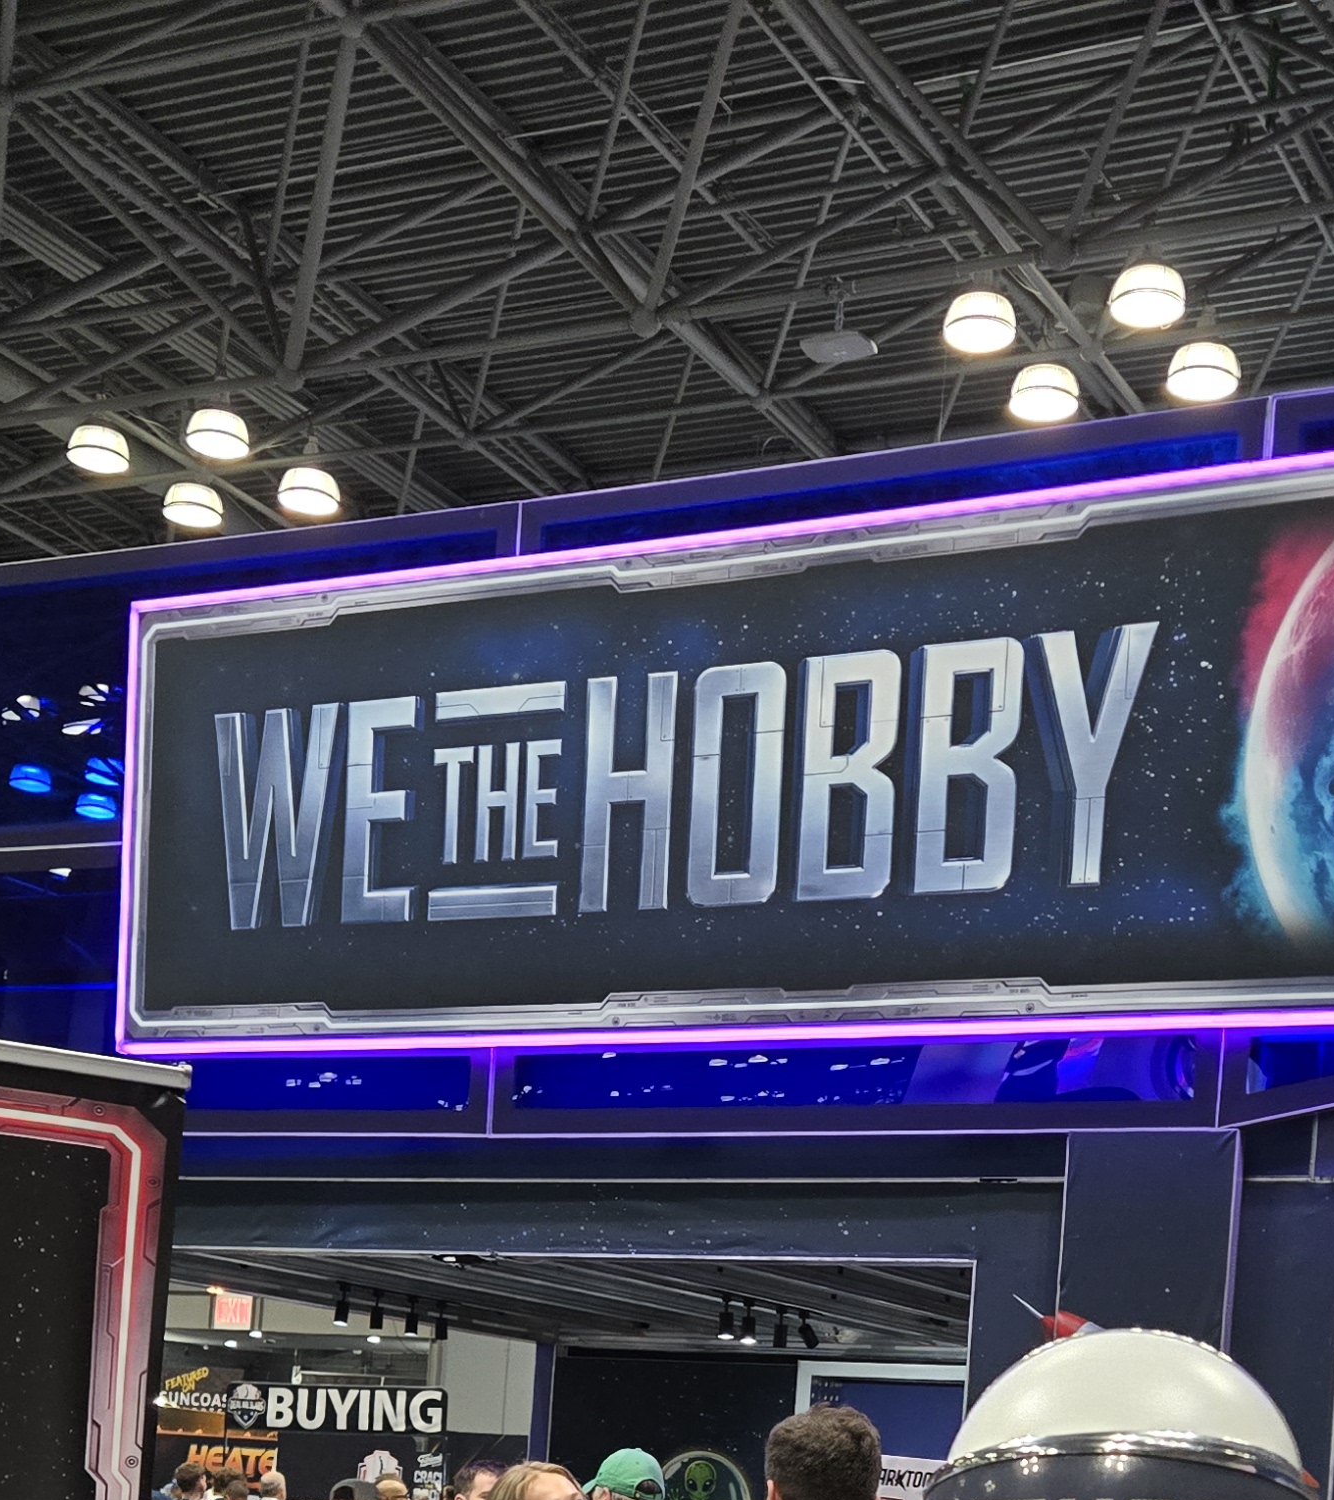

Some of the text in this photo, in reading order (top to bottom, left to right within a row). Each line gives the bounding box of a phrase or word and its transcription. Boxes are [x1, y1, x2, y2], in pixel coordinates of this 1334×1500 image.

[215, 620, 1160, 929] WE THE HOBBY
[219, 1297, 250, 1323] EXIT
[165, 1366, 209, 1390] FEATURED
[266, 1386, 444, 1433] BUYING
